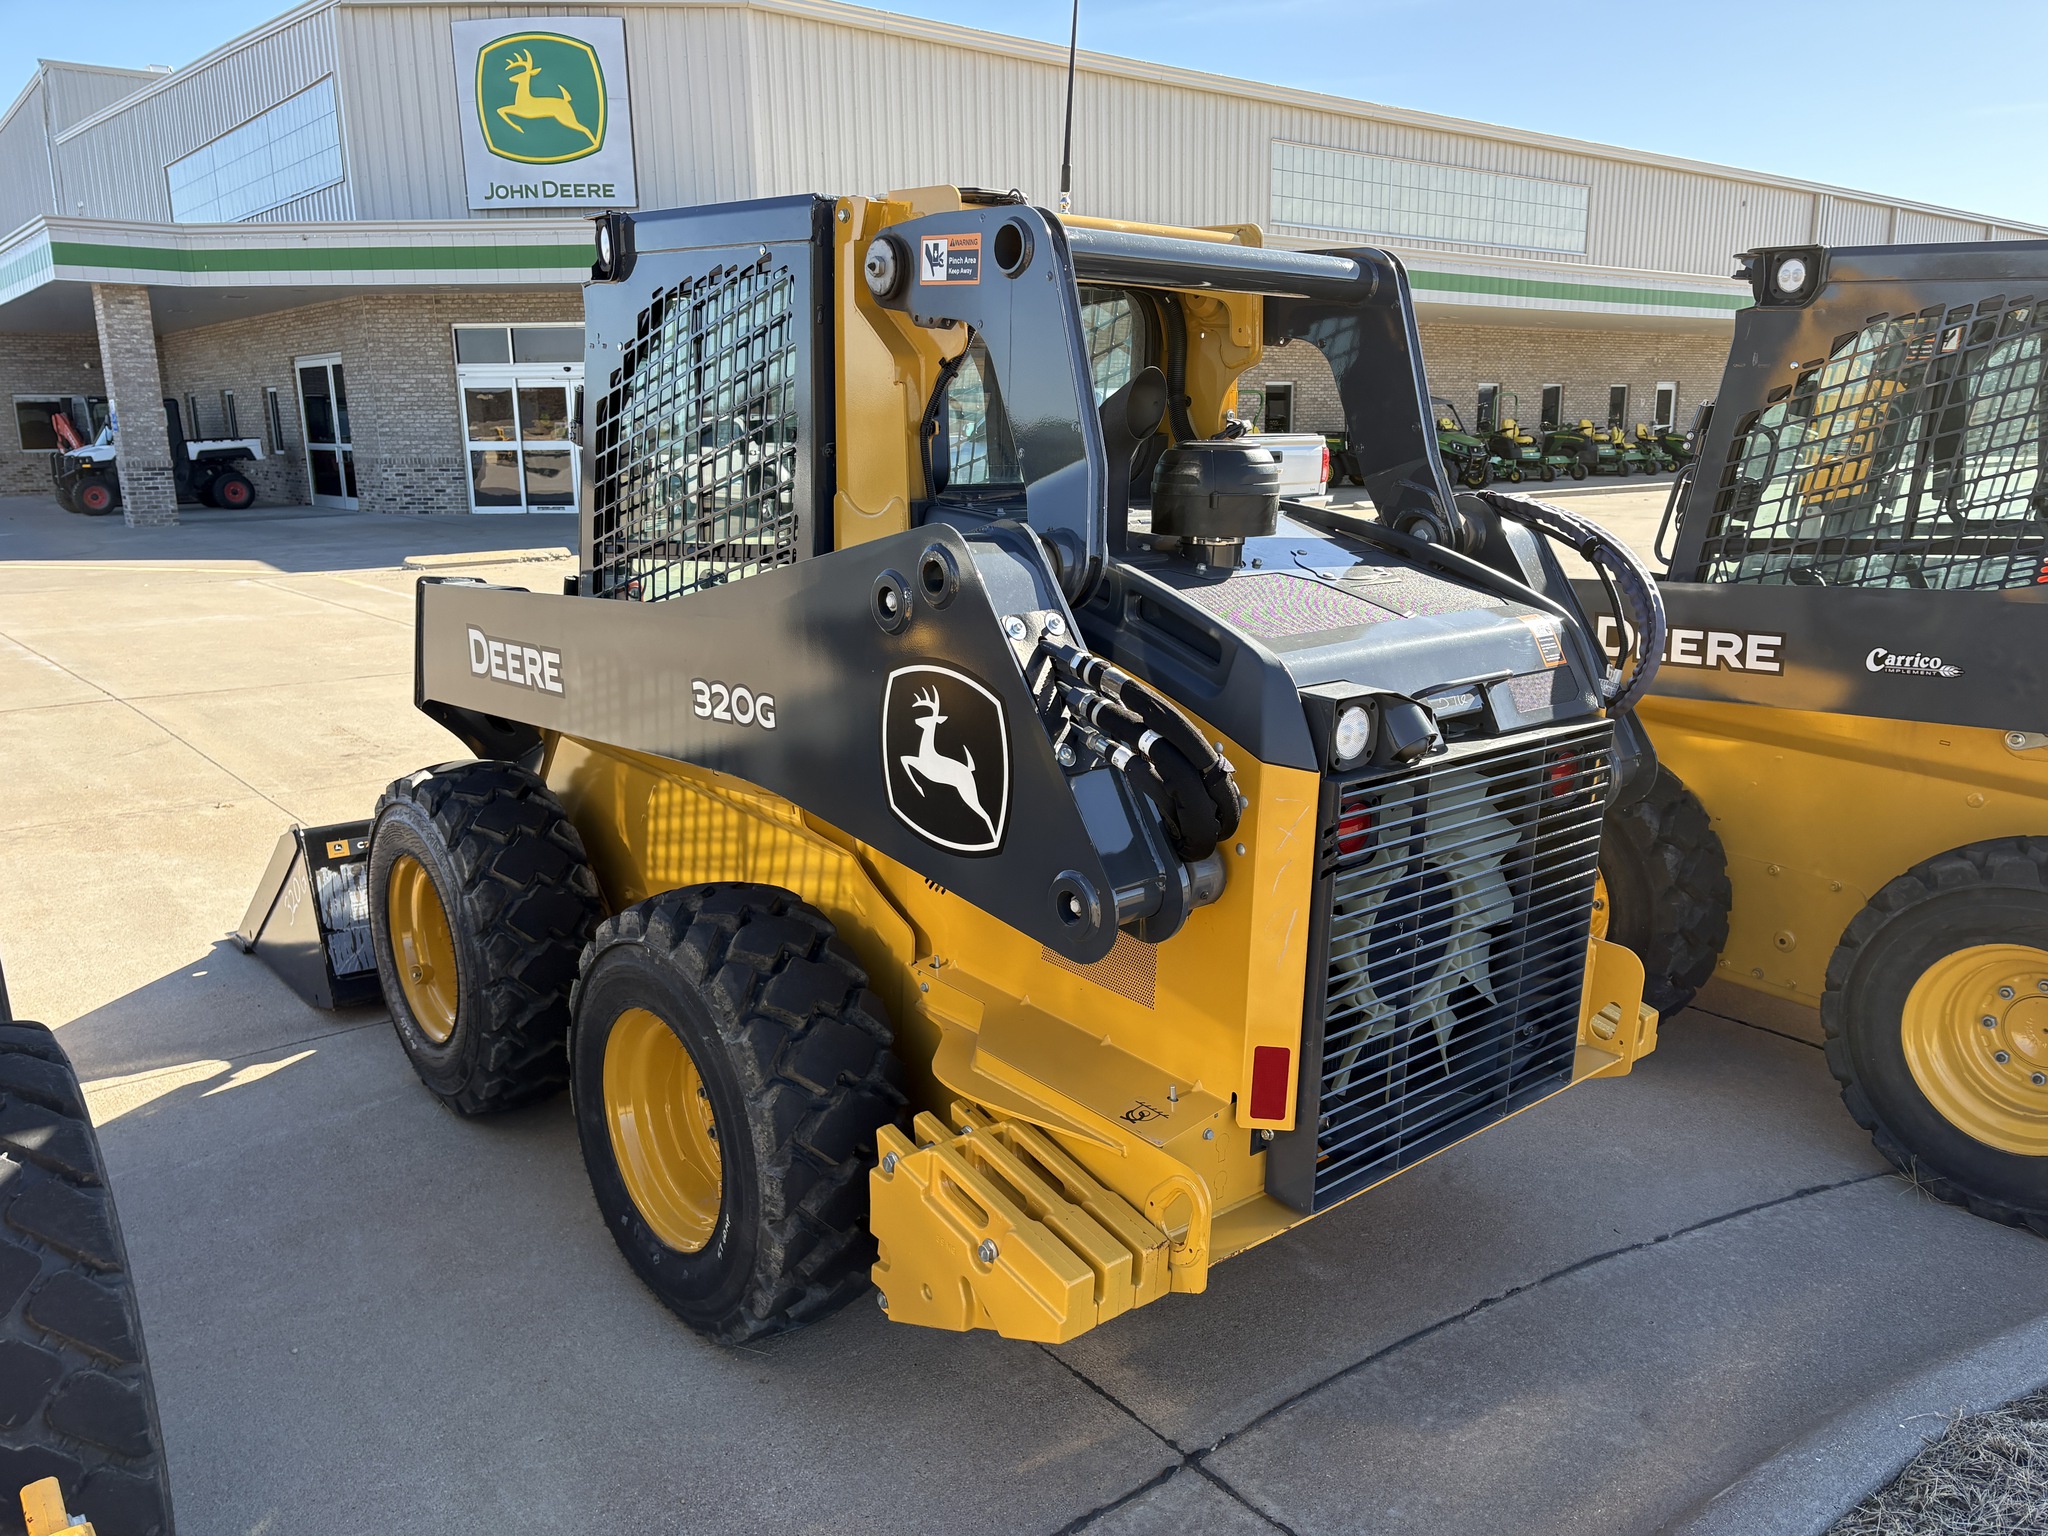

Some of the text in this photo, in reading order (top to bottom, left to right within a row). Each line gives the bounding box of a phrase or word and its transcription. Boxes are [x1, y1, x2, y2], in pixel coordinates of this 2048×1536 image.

[484, 180, 616, 200] JOHN DEERE
[954, 239, 978, 247] WARNING
[948, 256, 977, 264] Pinch Area
[948, 267, 973, 275] Keep Away
[1597, 615, 1782, 672] DERE
[467, 627, 563, 693] DEERE
[1865, 647, 1942, 672] Carrico
[1884, 667, 1938, 676] IMPLEMENT
[692, 680, 776, 729] 320G
